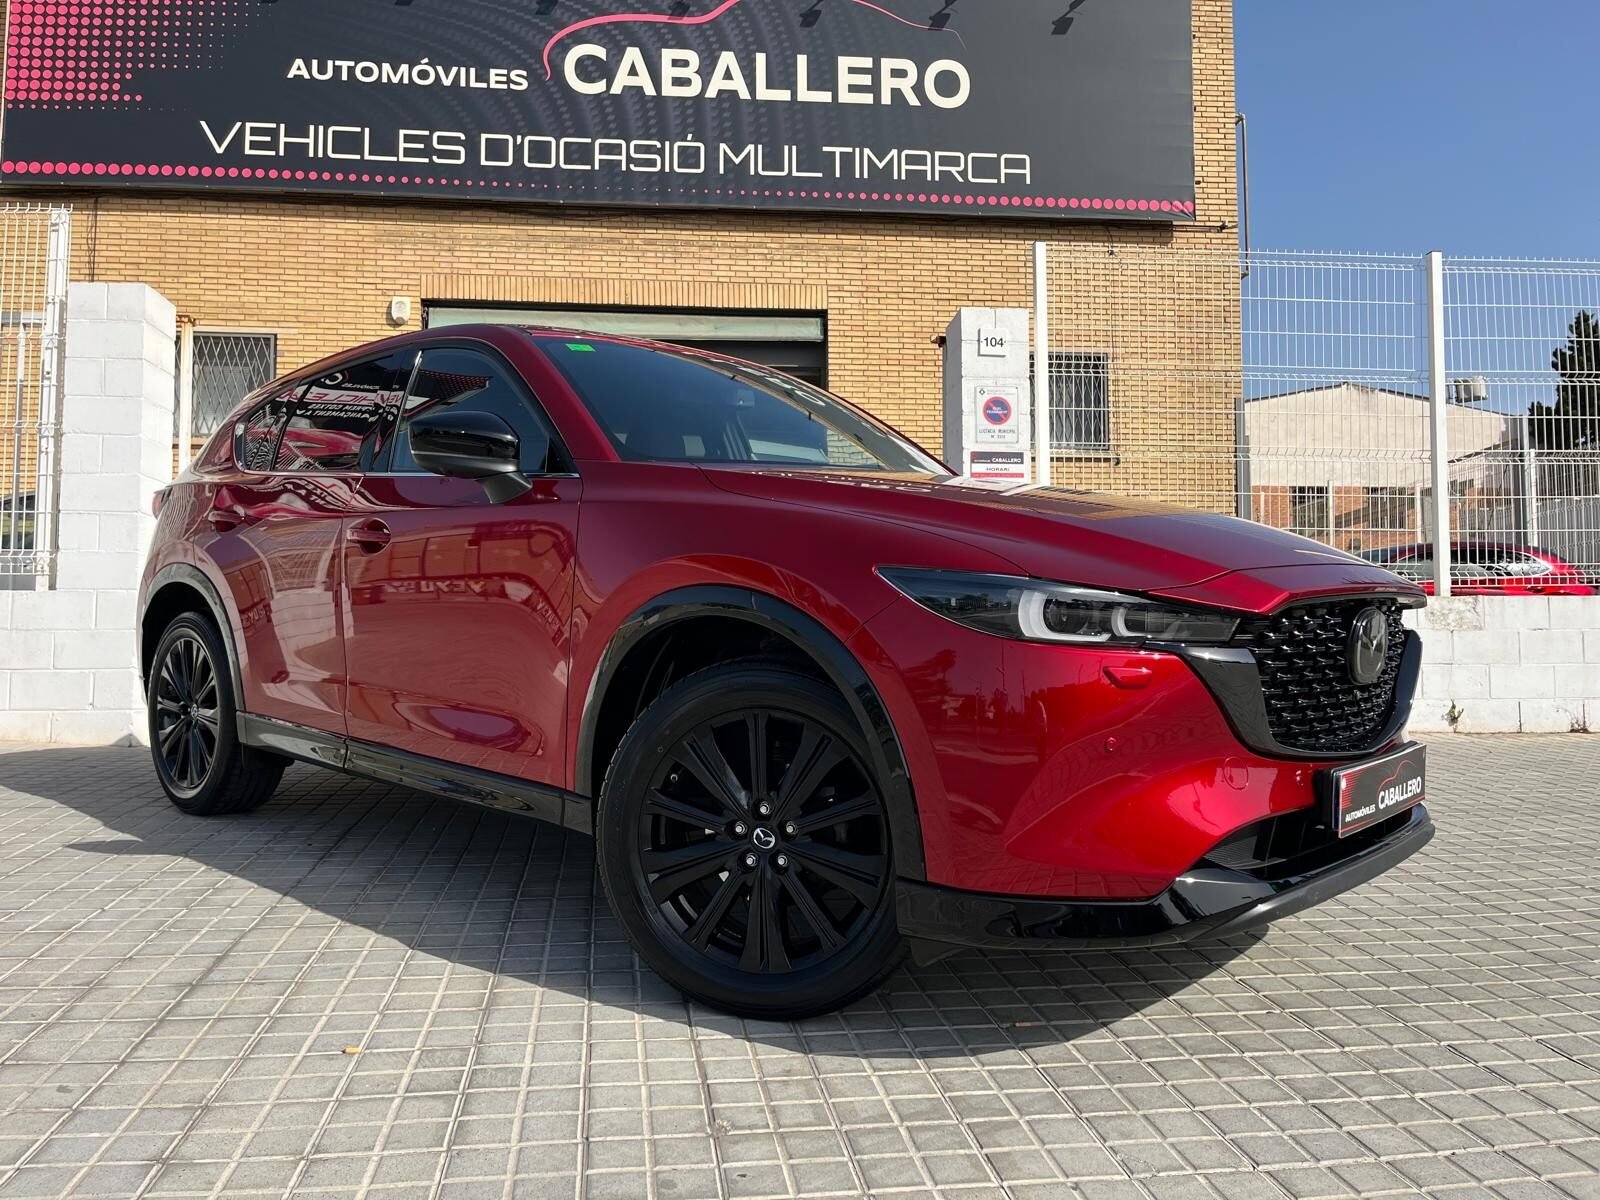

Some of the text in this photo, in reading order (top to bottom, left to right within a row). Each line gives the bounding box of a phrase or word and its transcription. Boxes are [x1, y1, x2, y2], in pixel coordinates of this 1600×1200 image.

[286, 43, 971, 109] AUTOMÓVILES CABALLERO
[199, 120, 1031, 187] VEHICLES D'OCASIÓ MULTIMARCA
[984, 337, 1004, 348] 104
[1345, 776, 1422, 822] AUTOMÓVILES CABALLERO
